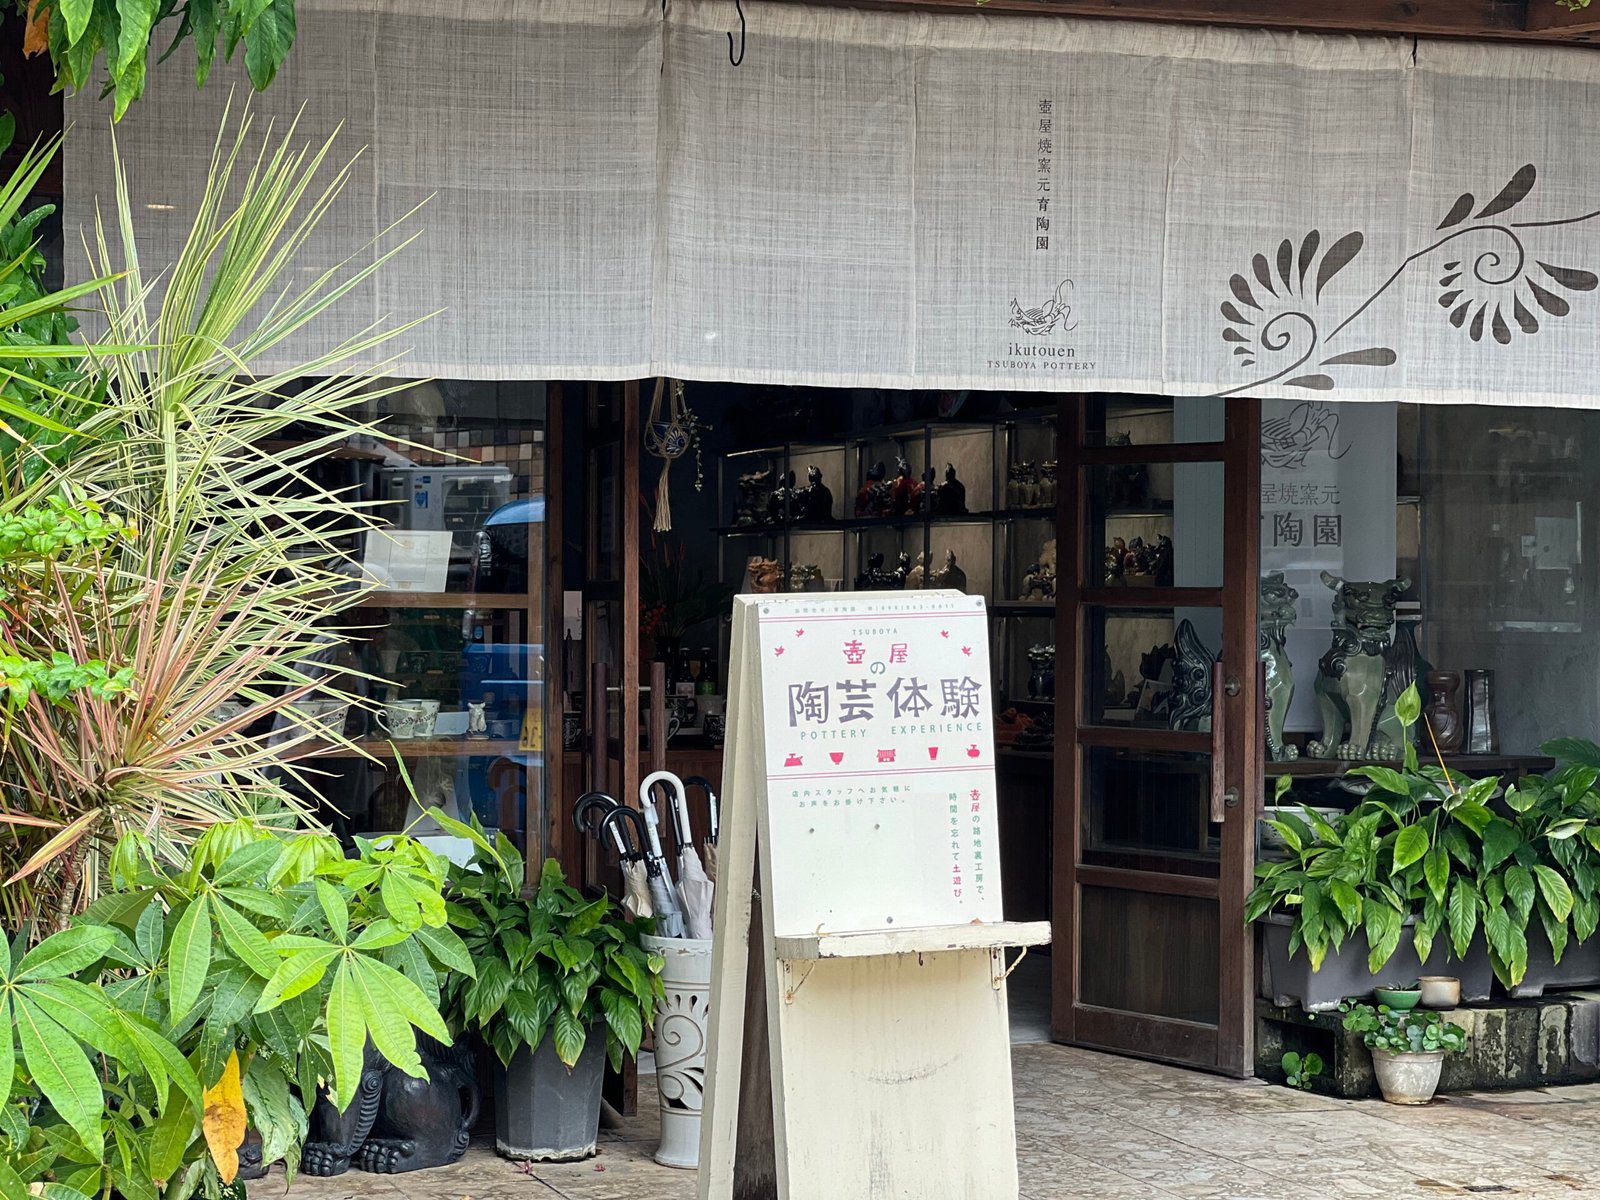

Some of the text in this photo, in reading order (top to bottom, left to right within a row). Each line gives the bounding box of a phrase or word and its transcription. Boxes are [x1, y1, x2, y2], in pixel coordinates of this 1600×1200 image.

[1008, 341, 1075, 357] ikutouen
[987, 360, 1097, 370] TSUBOYA POTTERY
[1260, 512, 1342, 547] 陶園
[788, 676, 982, 727] 陶芸体験
[801, 722, 983, 740] POTTERY EXPERIENCE
